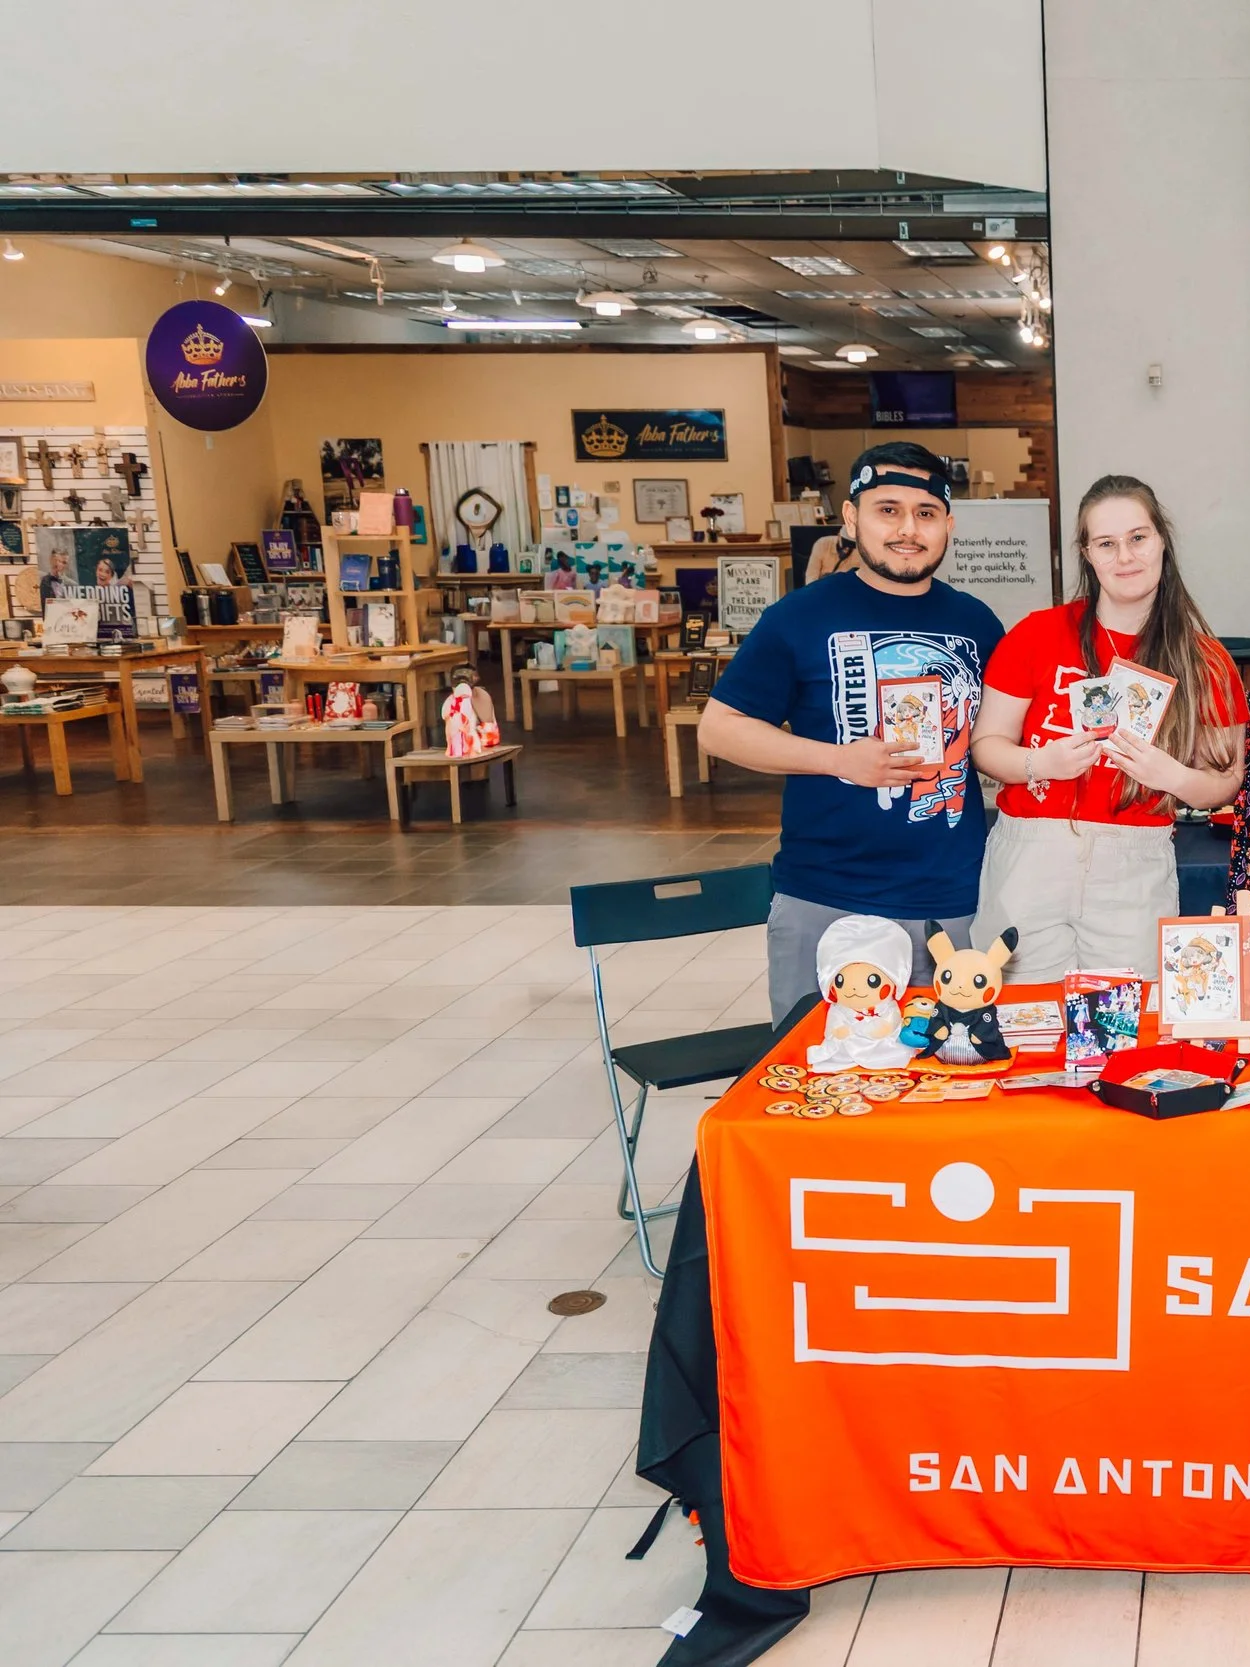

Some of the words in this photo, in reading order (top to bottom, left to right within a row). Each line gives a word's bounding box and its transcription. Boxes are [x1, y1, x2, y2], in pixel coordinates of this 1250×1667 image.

[171, 371, 198, 393] Abba
[876, 411, 904, 422] BIBLES
[636, 423, 666, 446] Abba
[953, 537, 992, 548] Patiently
[995, 537, 1028, 547] endure,
[955, 550, 985, 560] forgive
[988, 549, 1028, 560] instantly,
[956, 562, 967, 571] let
[970, 565, 982, 573] go
[985, 562, 1017, 573] quickly,
[1019, 562, 1026, 571] &
[948, 574, 966, 584] love
[968, 574, 1036, 585] unconditionally.
[62, 585, 129, 604] WEDDING
[101, 603, 131, 622] IFTS
[844, 655, 869, 742] LUNTEER
[909, 1452, 1028, 1493] SAN
